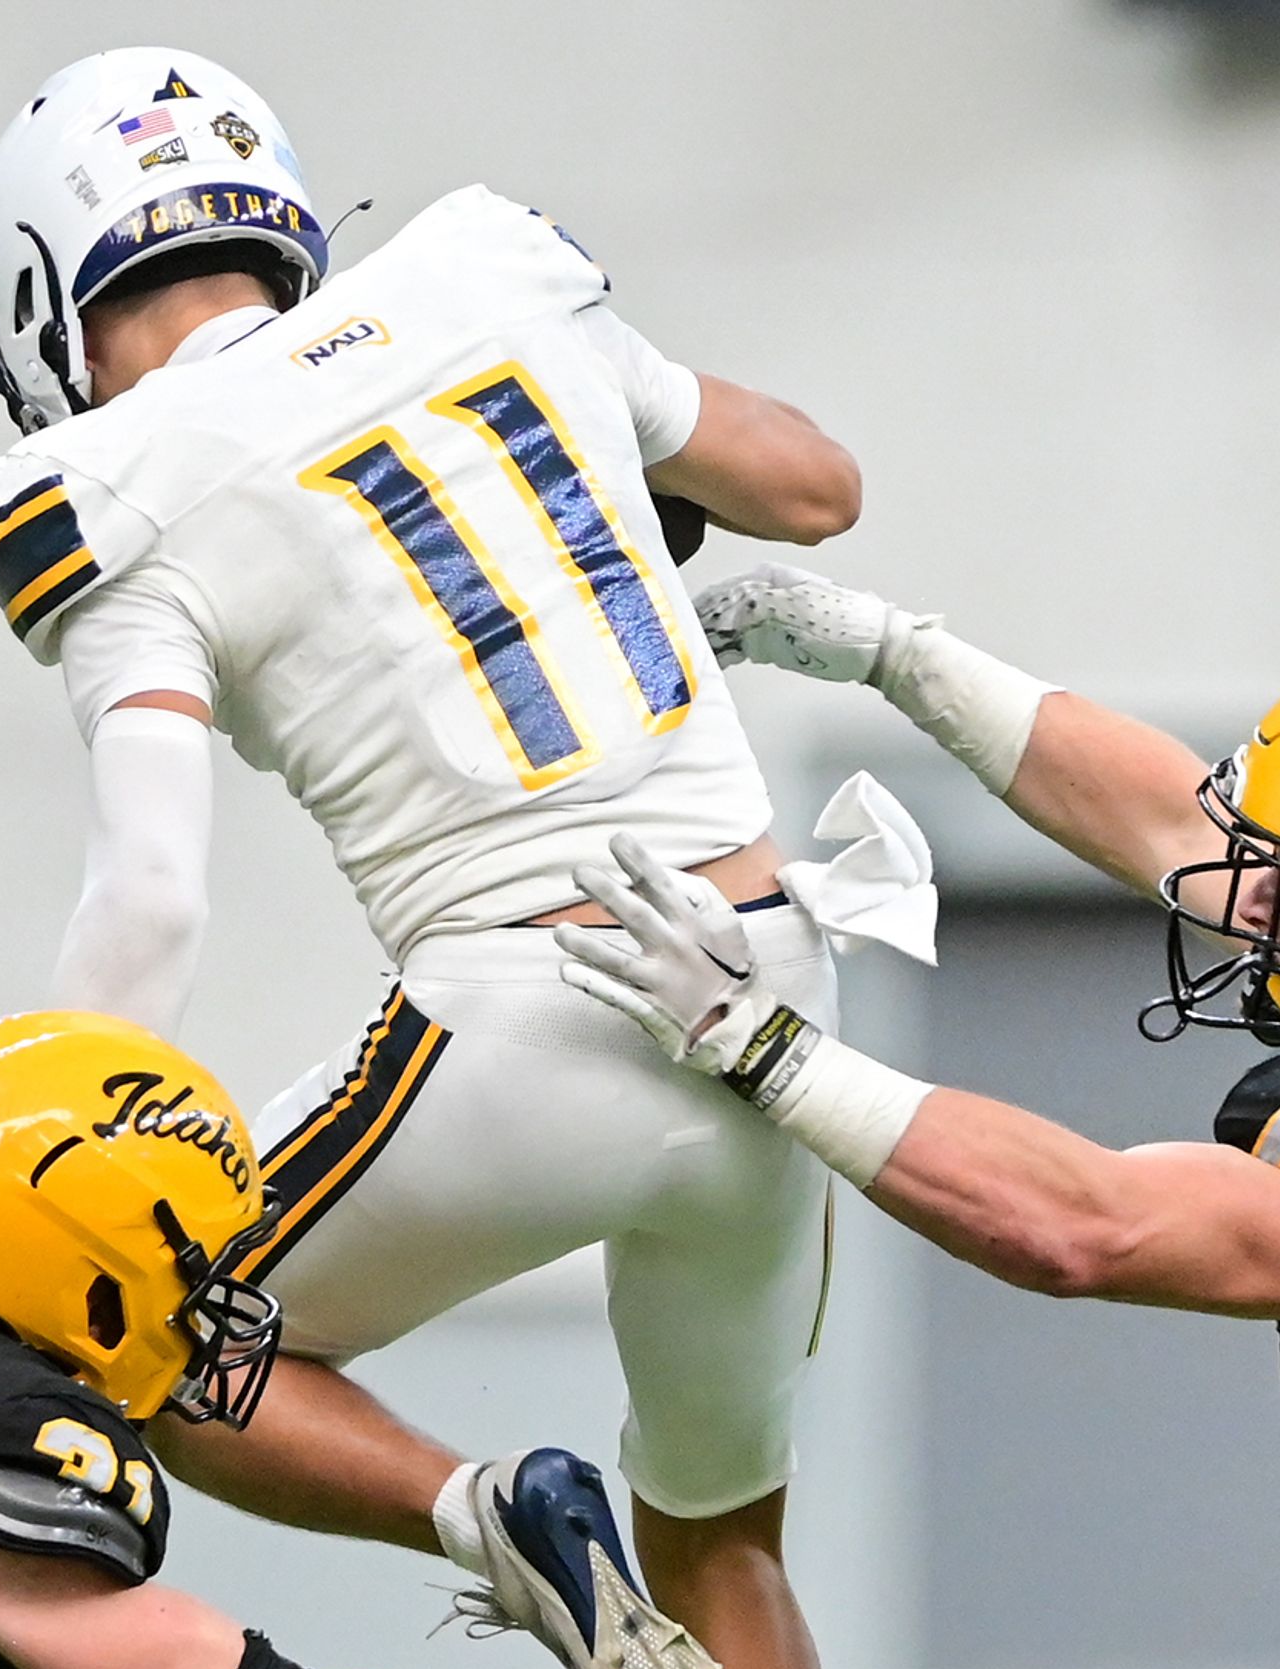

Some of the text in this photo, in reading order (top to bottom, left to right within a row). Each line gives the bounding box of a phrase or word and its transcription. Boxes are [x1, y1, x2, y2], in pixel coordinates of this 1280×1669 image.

[127, 191, 302, 244] TOGETHER
[302, 323, 375, 367] NAU
[296, 358, 699, 792] 11
[91, 1071, 250, 1194] Idaho
